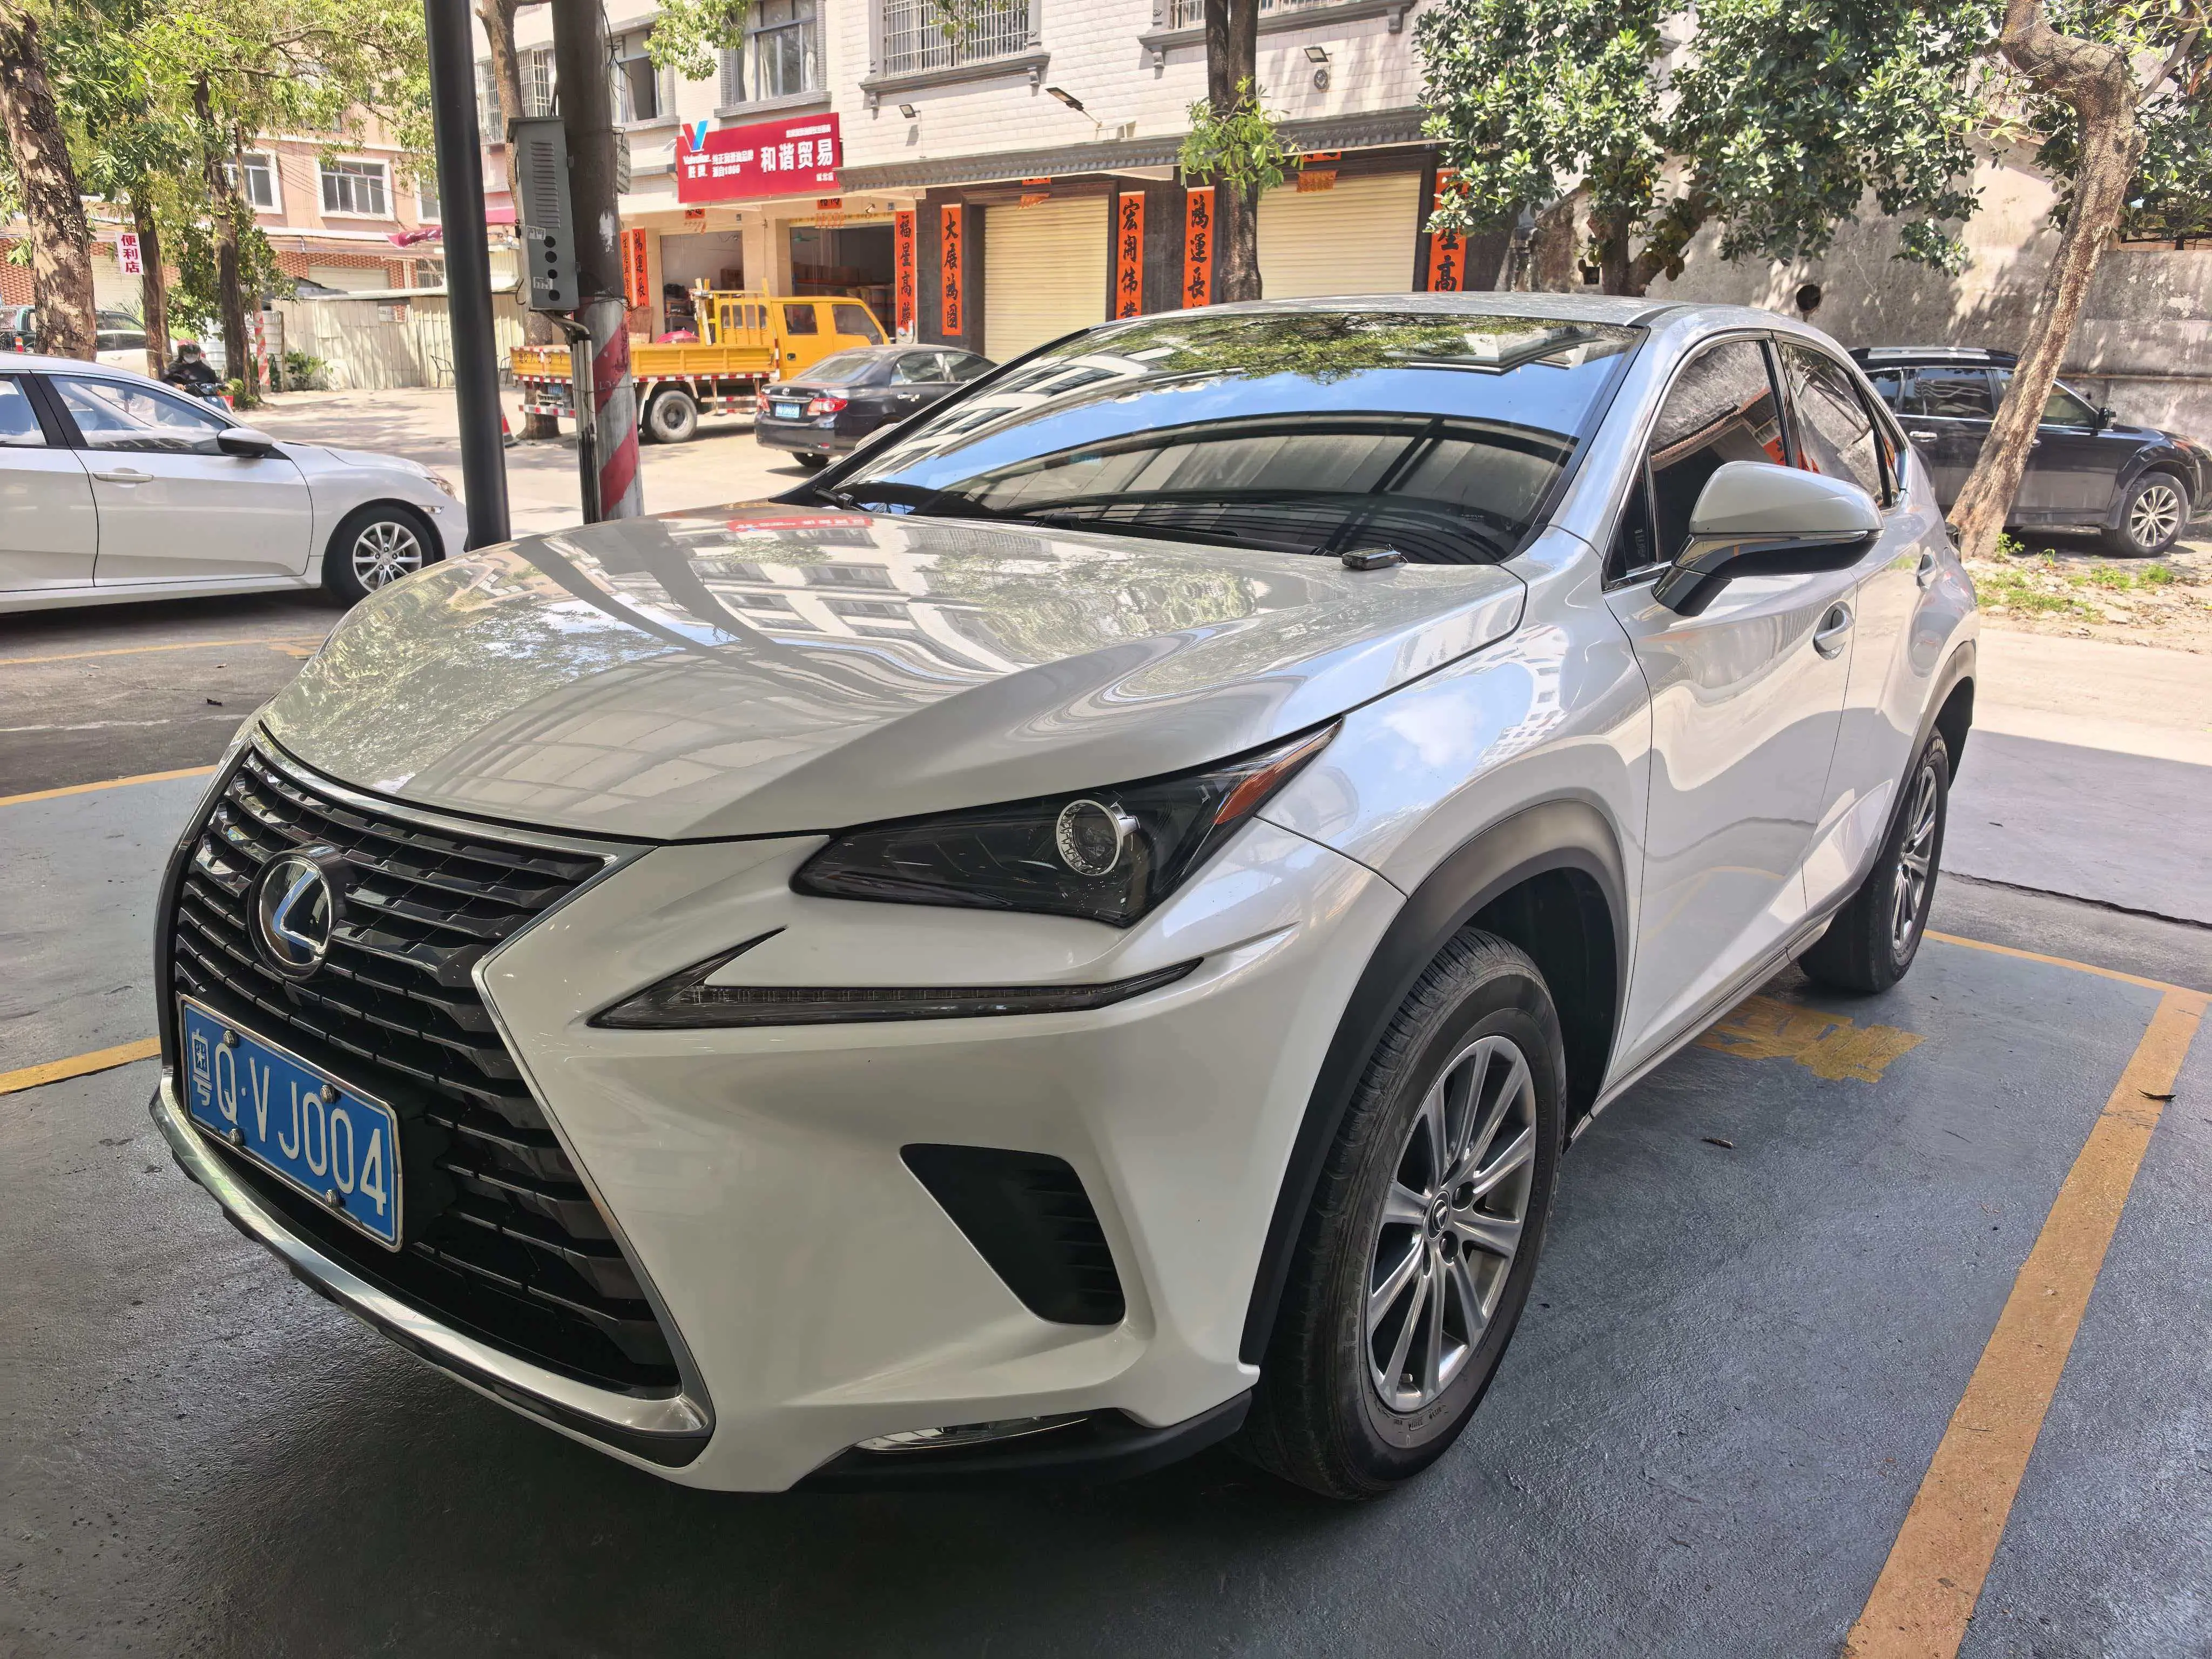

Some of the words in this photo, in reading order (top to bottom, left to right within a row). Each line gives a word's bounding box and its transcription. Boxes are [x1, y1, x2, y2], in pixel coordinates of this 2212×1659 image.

[760, 138, 833, 173] 和谐贸易
[121, 234, 140, 273] 便利店
